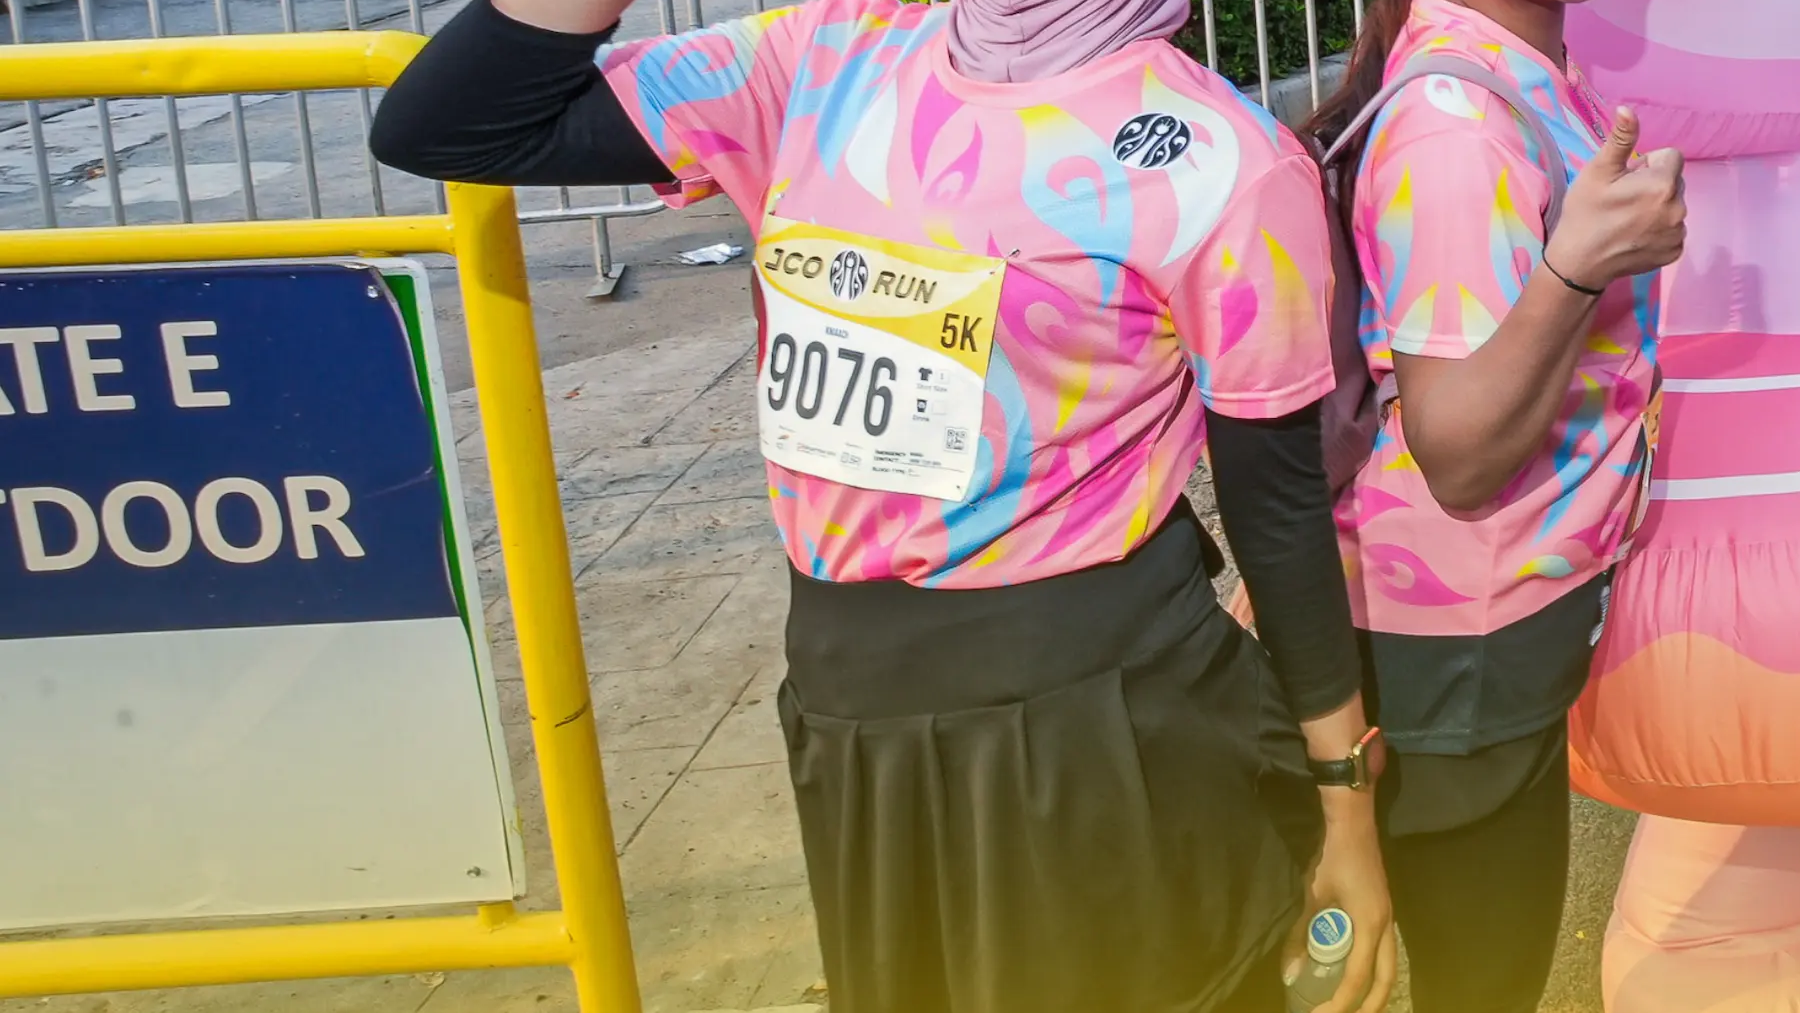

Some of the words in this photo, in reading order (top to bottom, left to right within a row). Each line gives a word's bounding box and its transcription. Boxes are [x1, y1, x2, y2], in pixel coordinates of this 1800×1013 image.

[764, 248, 824, 279] JCO
[872, 270, 938, 304] RUN
[0, 324, 136, 418] TE
[160, 320, 231, 409] E
[940, 312, 982, 353] 5K
[767, 333, 898, 437] 9076
[0, 475, 366, 573] DOOR
